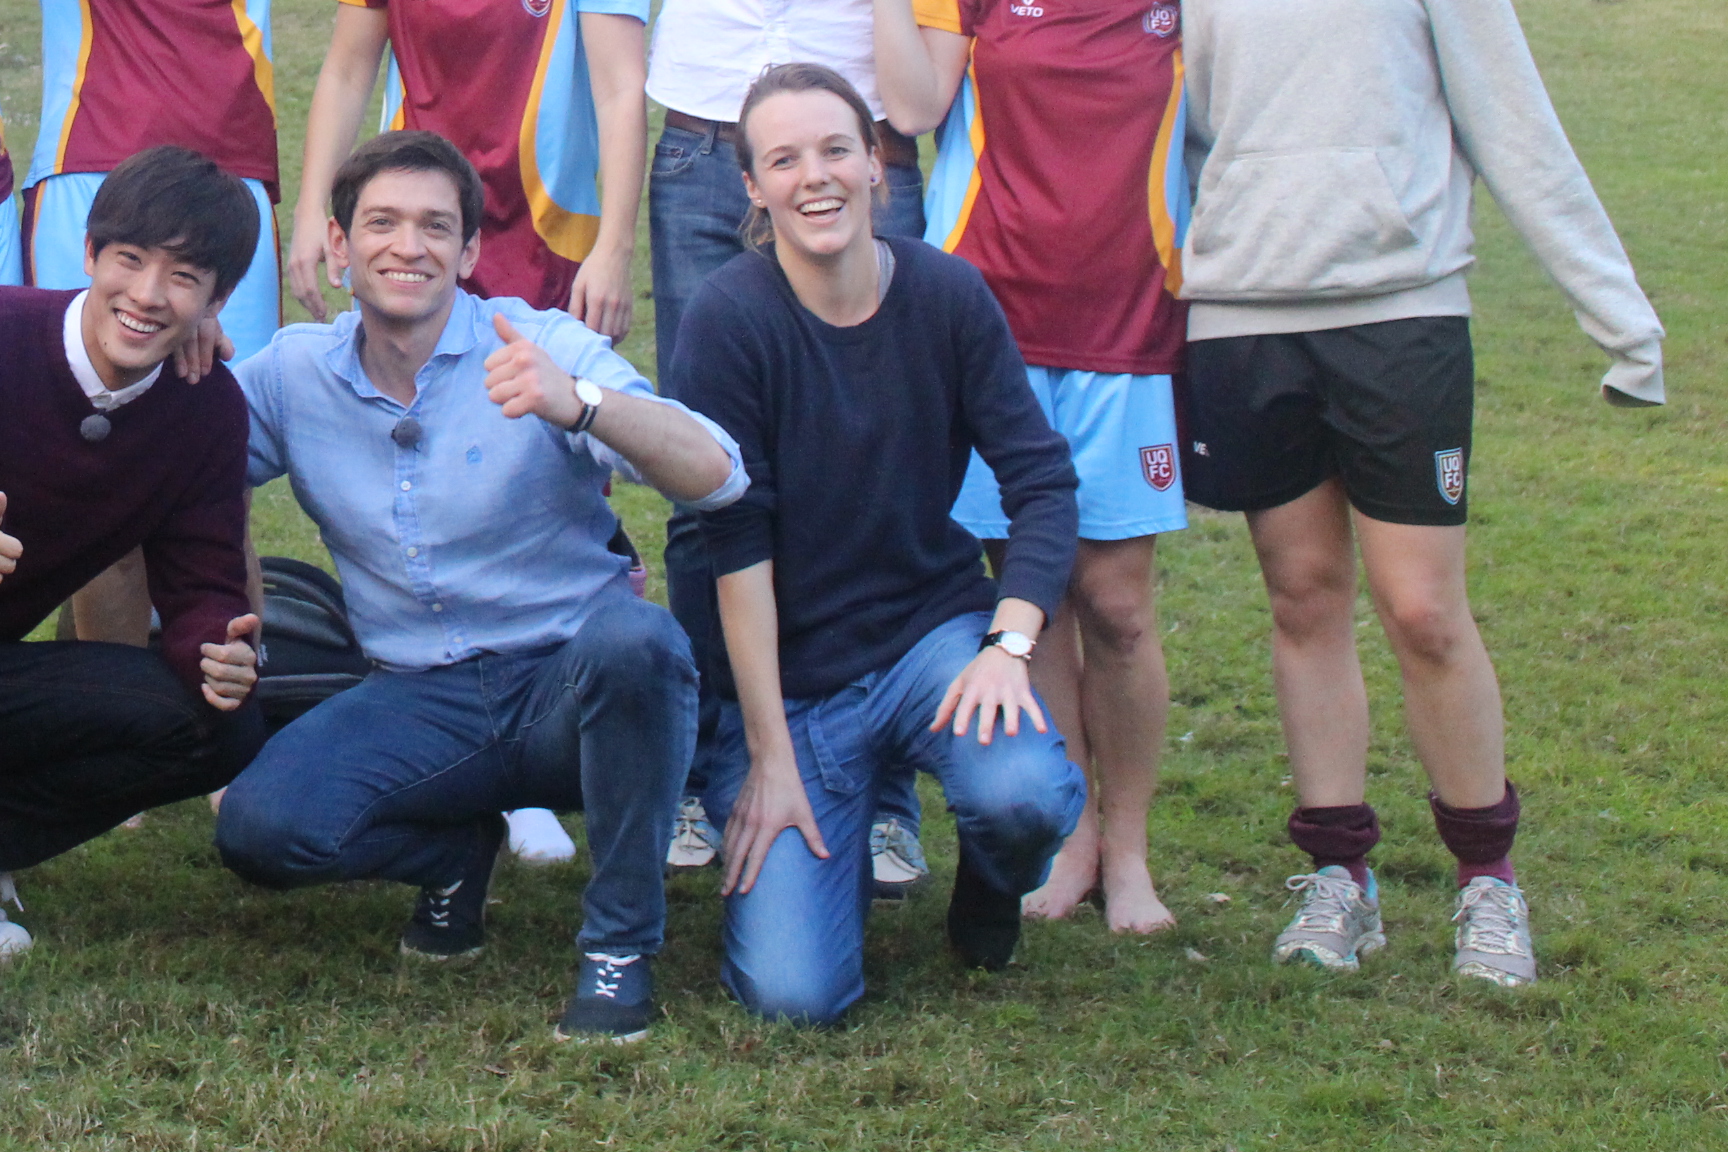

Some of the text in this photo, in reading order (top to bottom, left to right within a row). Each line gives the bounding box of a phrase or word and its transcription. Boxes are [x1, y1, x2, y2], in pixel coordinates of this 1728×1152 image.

[1010, 3, 1044, 18] VETO
[1146, 449, 1168, 465] UQ
[1149, 463, 1170, 480] FC
[1445, 471, 1460, 489] FC
